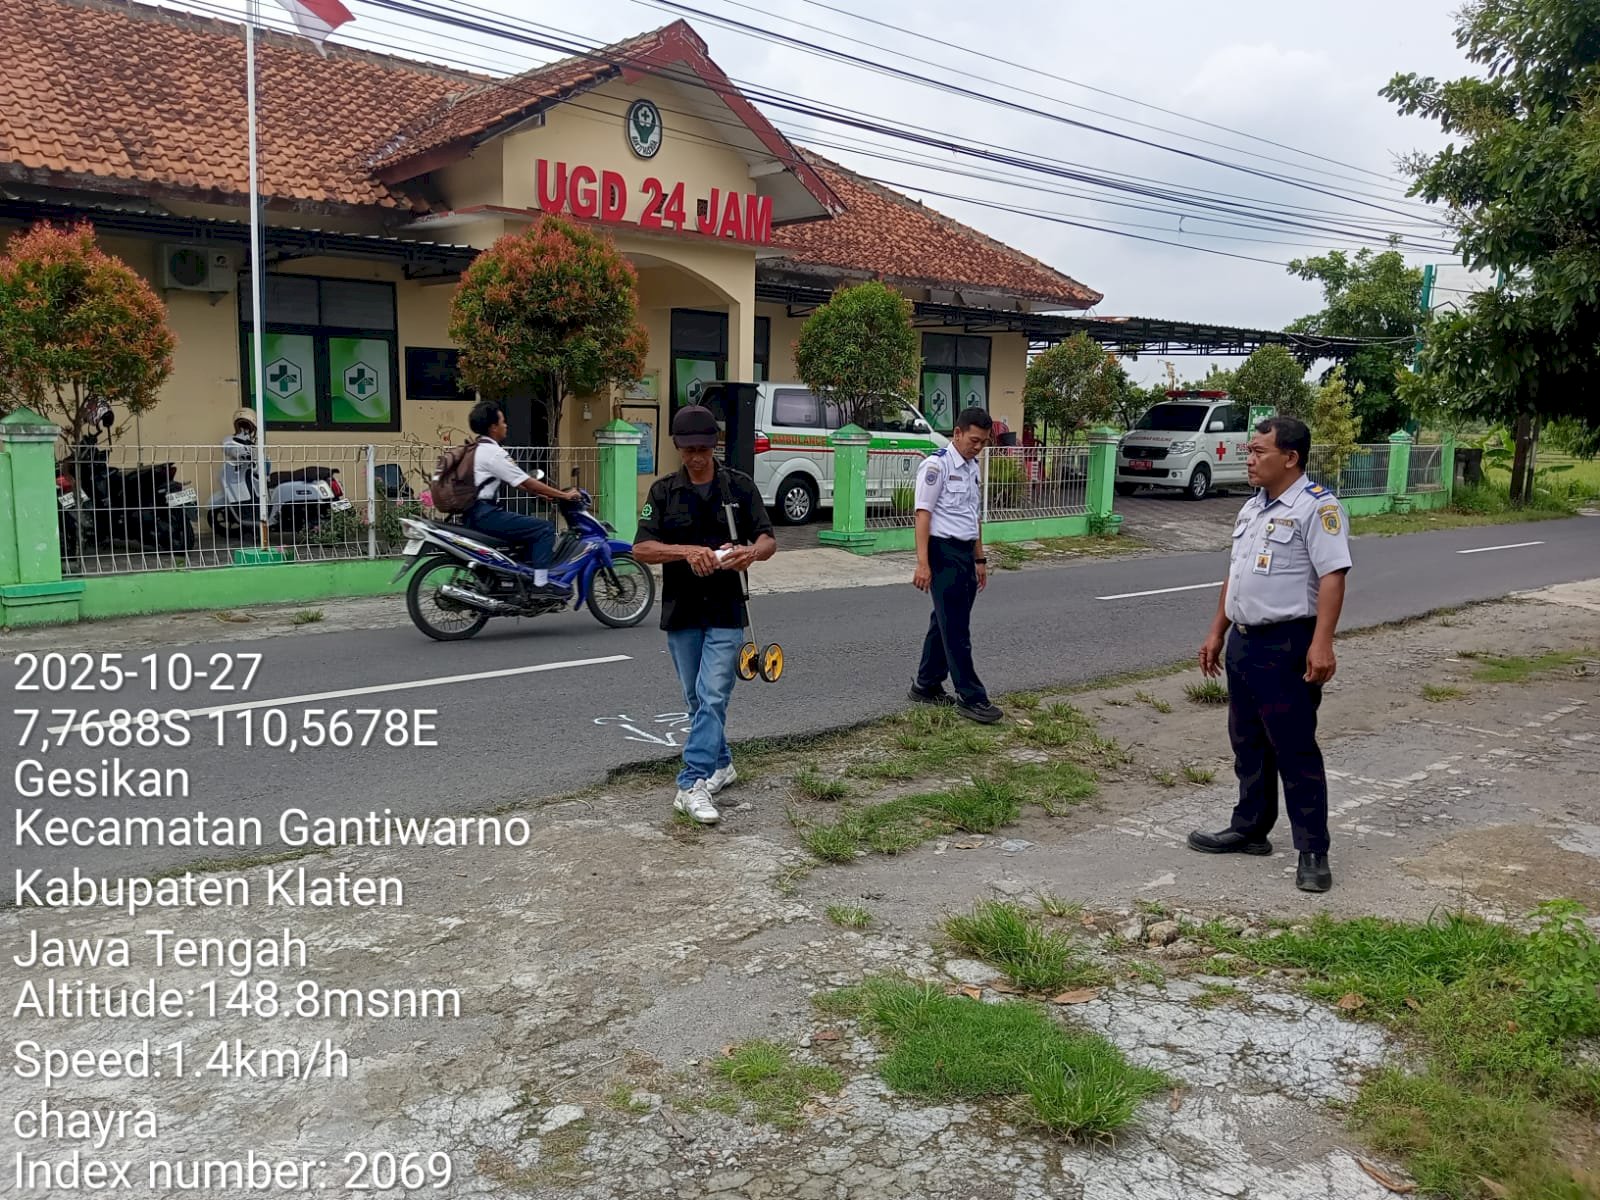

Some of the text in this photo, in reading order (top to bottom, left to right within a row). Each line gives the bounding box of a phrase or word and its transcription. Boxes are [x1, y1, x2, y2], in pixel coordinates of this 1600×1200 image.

[536, 159, 774, 243] UGD 24 JAM
[771, 434, 826, 447] AMBULANCE
